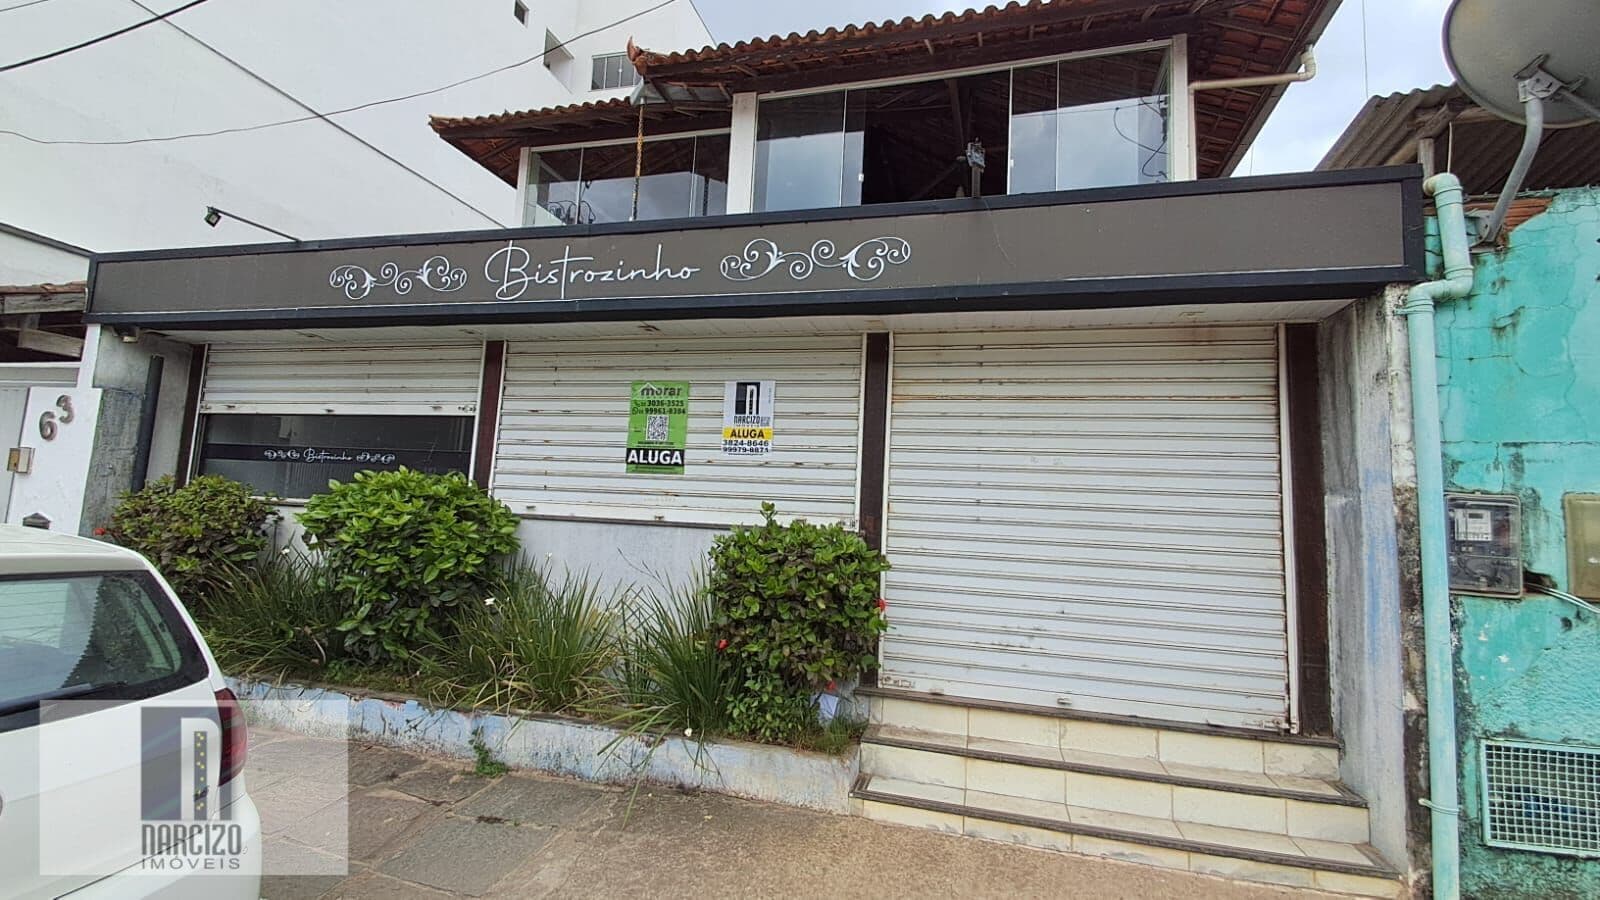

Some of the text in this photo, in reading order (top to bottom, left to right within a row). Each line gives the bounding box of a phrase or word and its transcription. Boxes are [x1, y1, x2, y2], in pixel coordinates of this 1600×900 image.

[484, 240, 700, 301] Bistrozinho
[640, 386, 682, 396] morar
[39, 394, 74, 441] 63
[734, 415, 761, 425] NARCIZO
[730, 429, 765, 439] ALUGA
[627, 449, 682, 465] ALUGA
